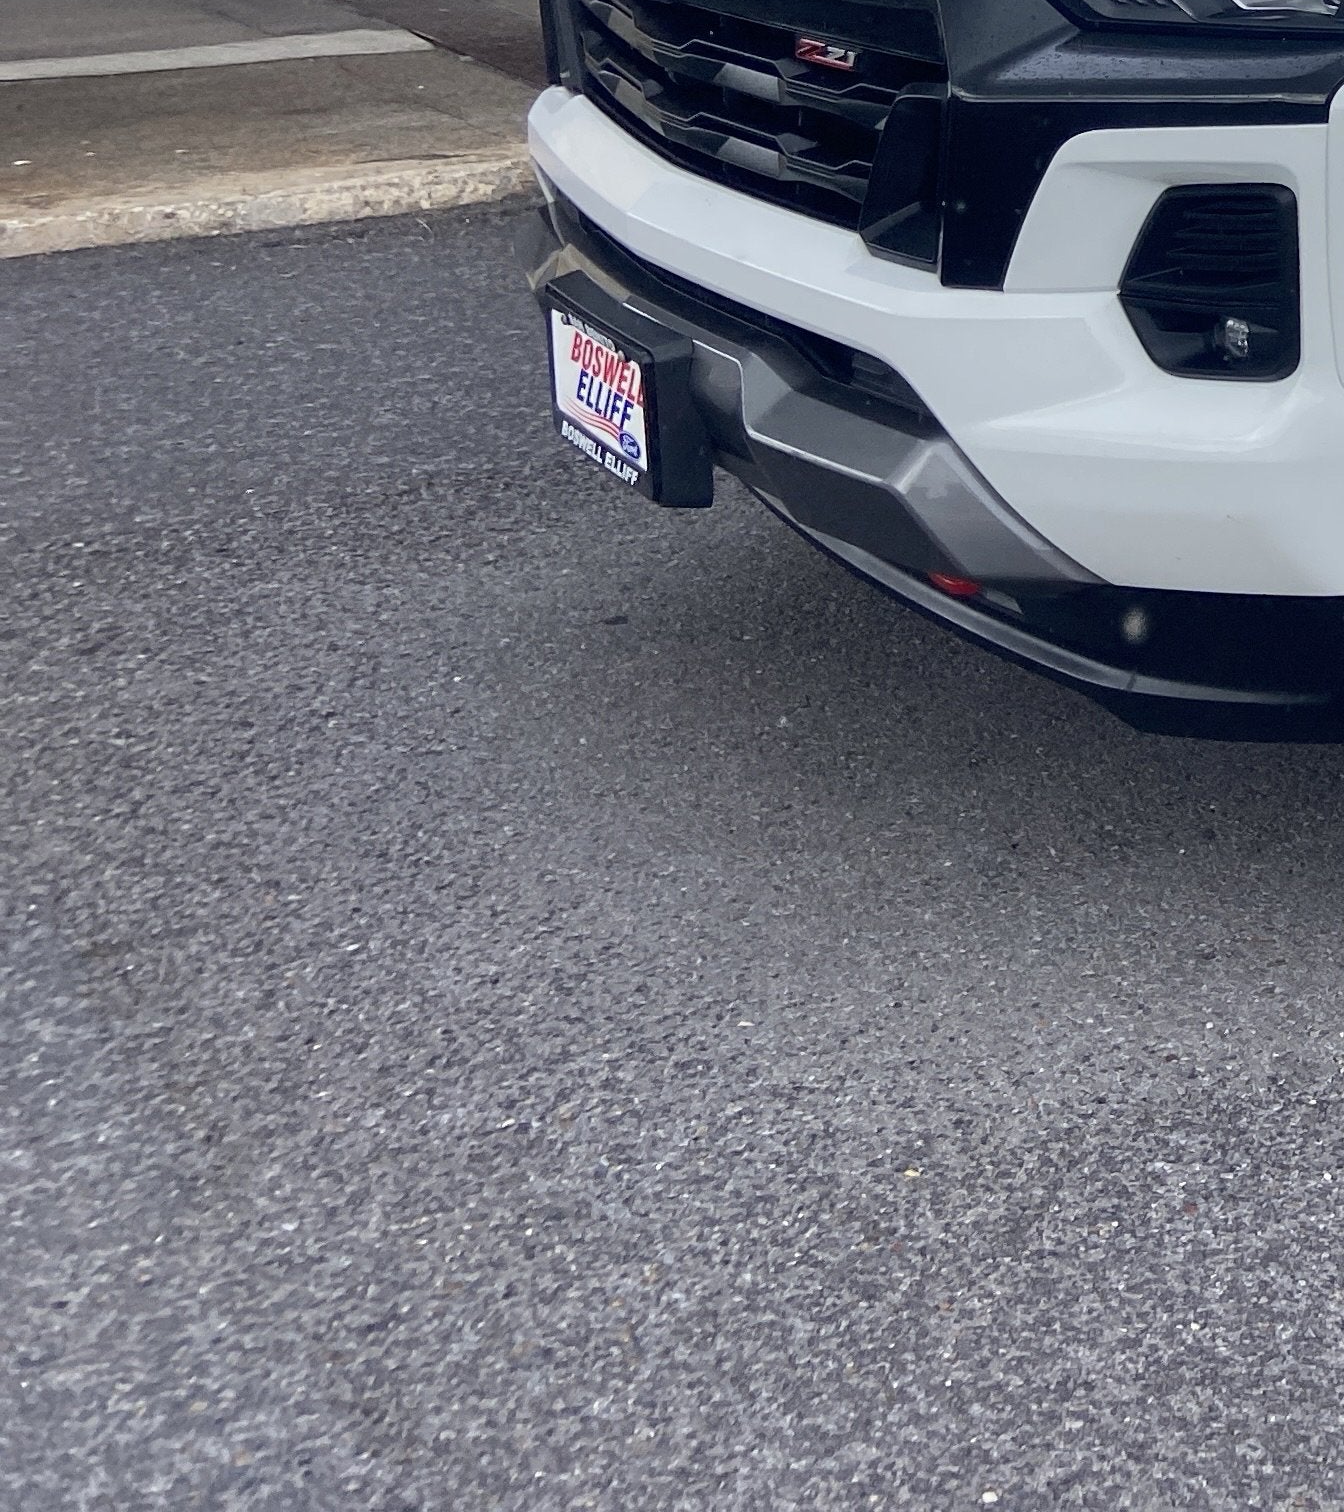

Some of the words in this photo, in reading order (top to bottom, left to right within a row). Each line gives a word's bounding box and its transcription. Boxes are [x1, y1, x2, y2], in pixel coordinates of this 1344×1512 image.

[796, 37, 857, 72] Z71
[575, 368, 634, 432] ELLIFF
[561, 420, 604, 464] BOSWELL
[604, 451, 639, 486] ELLIFF
